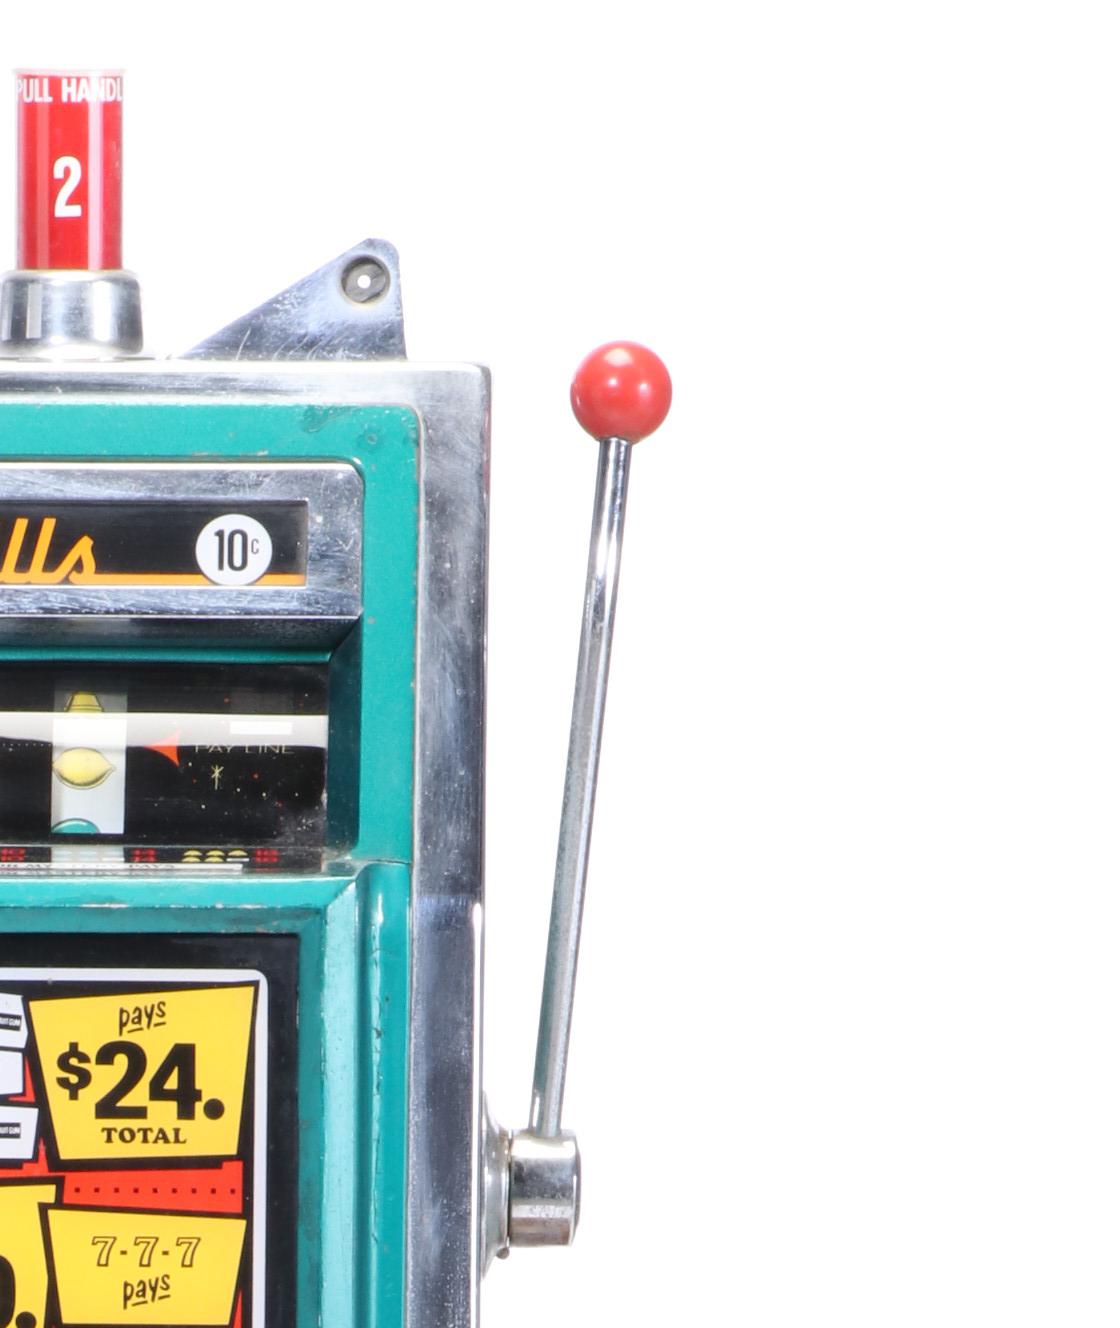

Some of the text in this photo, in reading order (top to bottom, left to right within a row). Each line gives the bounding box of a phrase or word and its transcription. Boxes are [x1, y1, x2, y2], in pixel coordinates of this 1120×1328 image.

[16, 77, 53, 102] PULL
[53, 156, 82, 218] 2
[195, 744, 295, 754] PAY LINE
[119, 1001, 166, 1036] pays
[101, 1127, 187, 1144] TOTAL
[123, 1274, 171, 1310] pays
